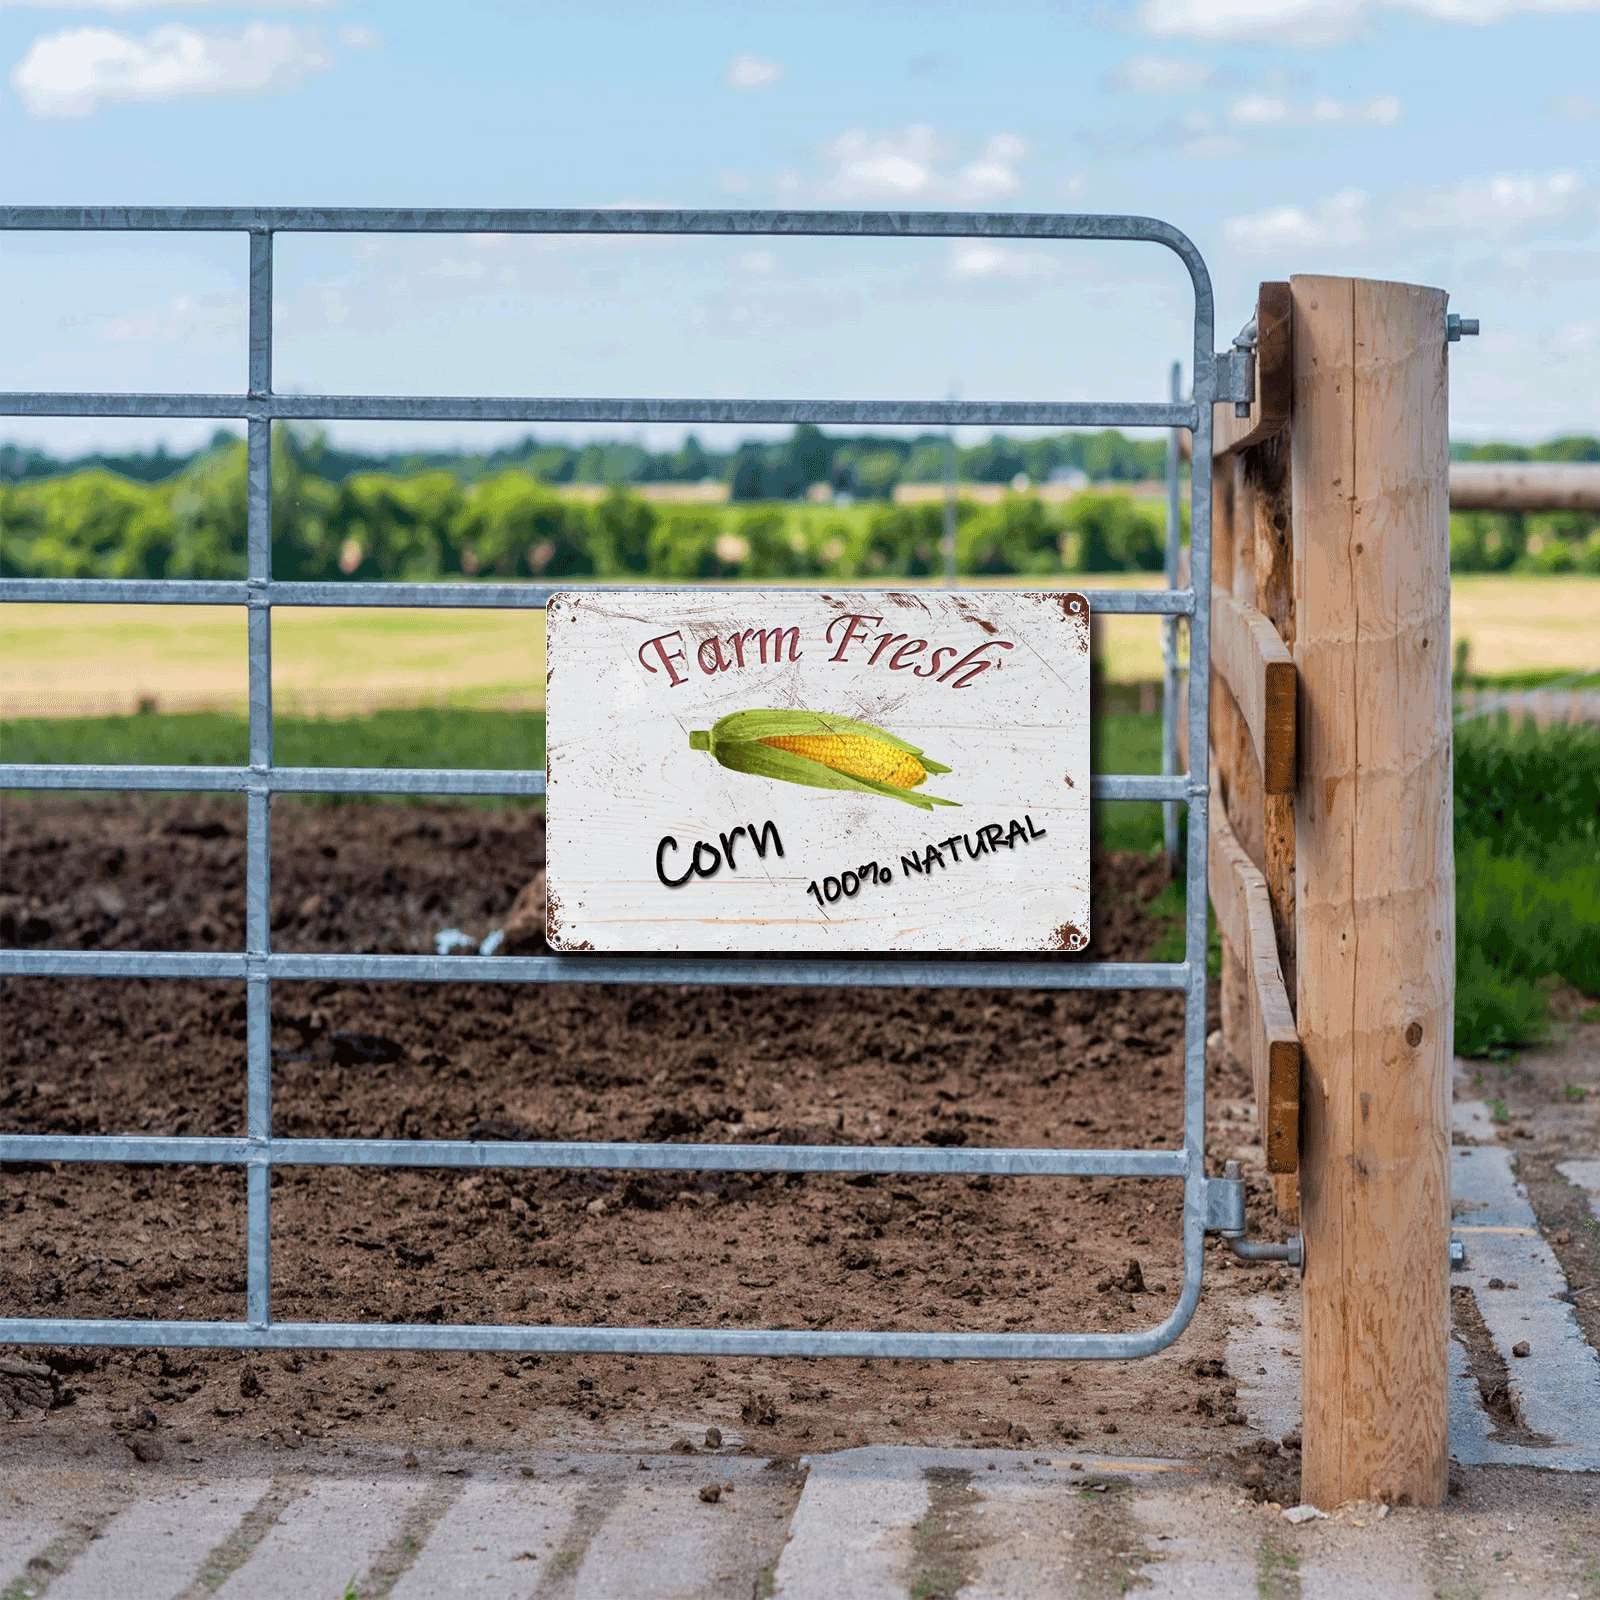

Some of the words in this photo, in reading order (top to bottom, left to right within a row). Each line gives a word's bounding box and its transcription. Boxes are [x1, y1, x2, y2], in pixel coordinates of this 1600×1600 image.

[638, 626, 803, 688] Farm
[825, 614, 1015, 689] Fresh
[655, 820, 784, 888] Corn
[806, 861, 893, 906] 100%
[900, 814, 1047, 876] NATURAL
